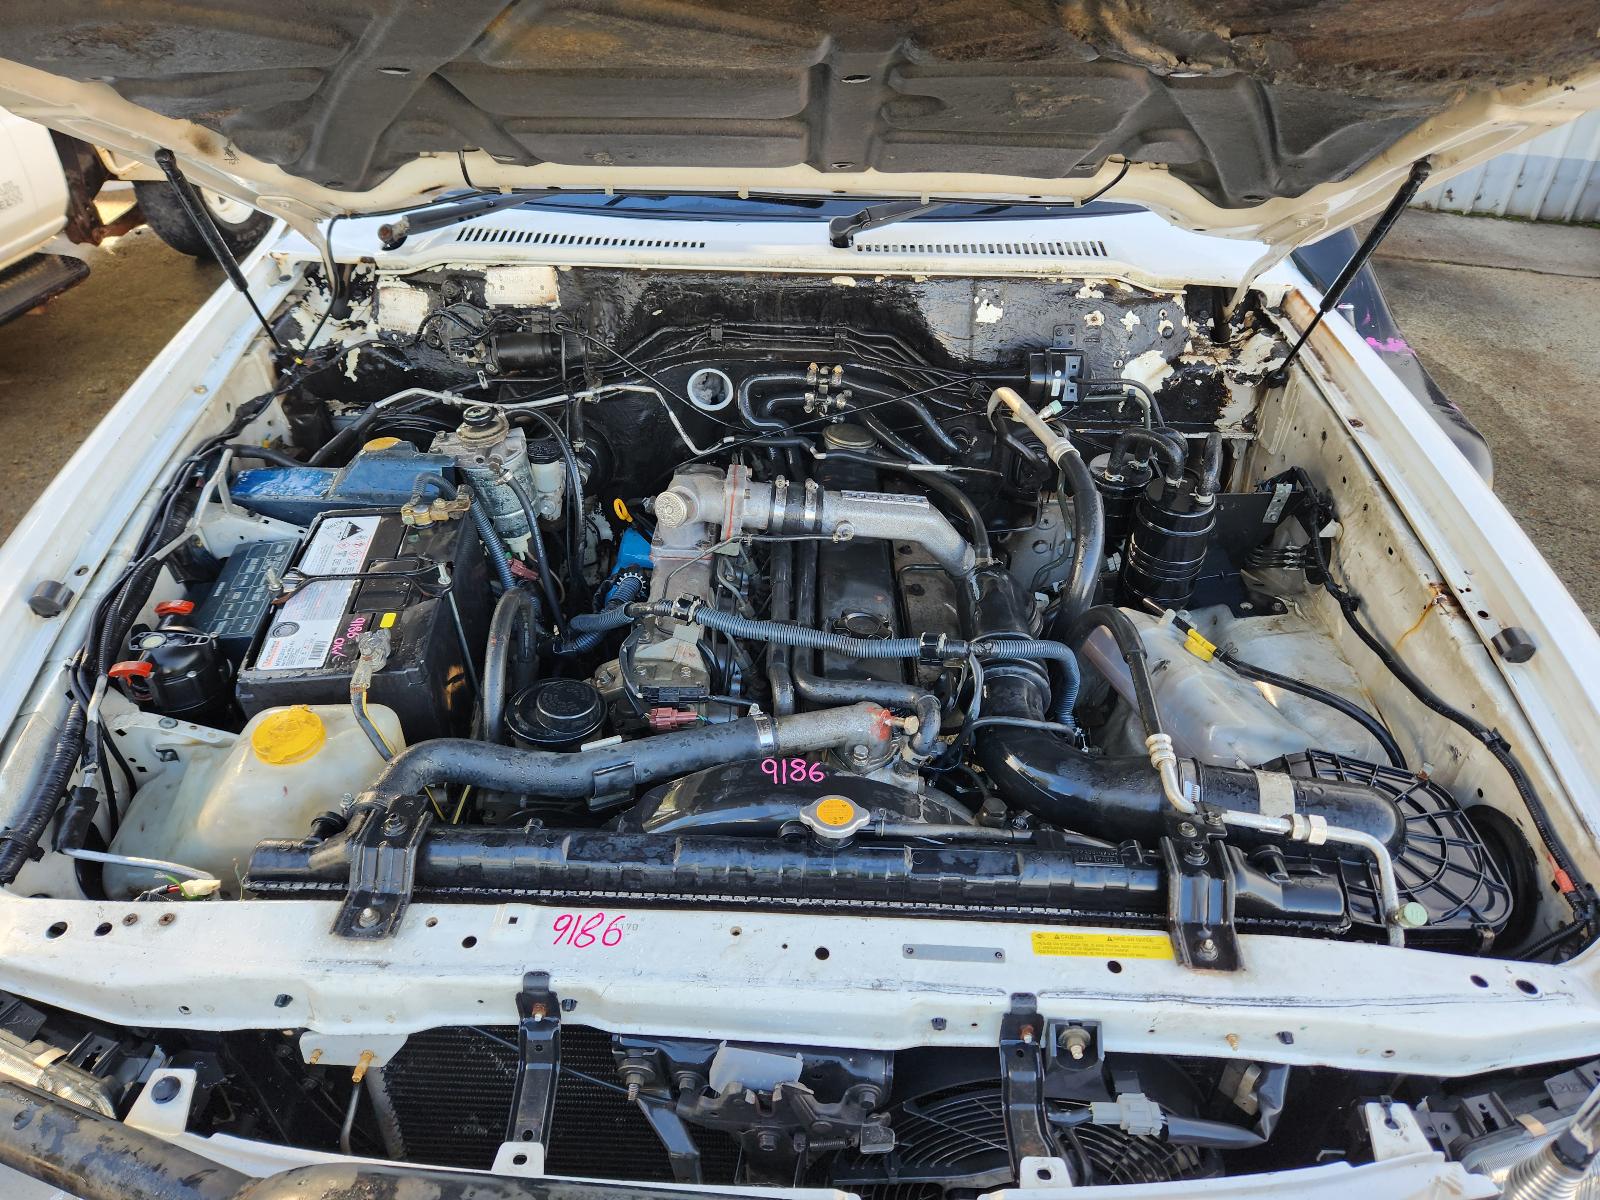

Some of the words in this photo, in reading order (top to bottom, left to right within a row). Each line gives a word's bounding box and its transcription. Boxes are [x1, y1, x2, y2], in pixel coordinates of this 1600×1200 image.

[347, 617, 365, 638] 9186
[761, 758, 825, 785] 9186
[553, 912, 626, 948] 9186
